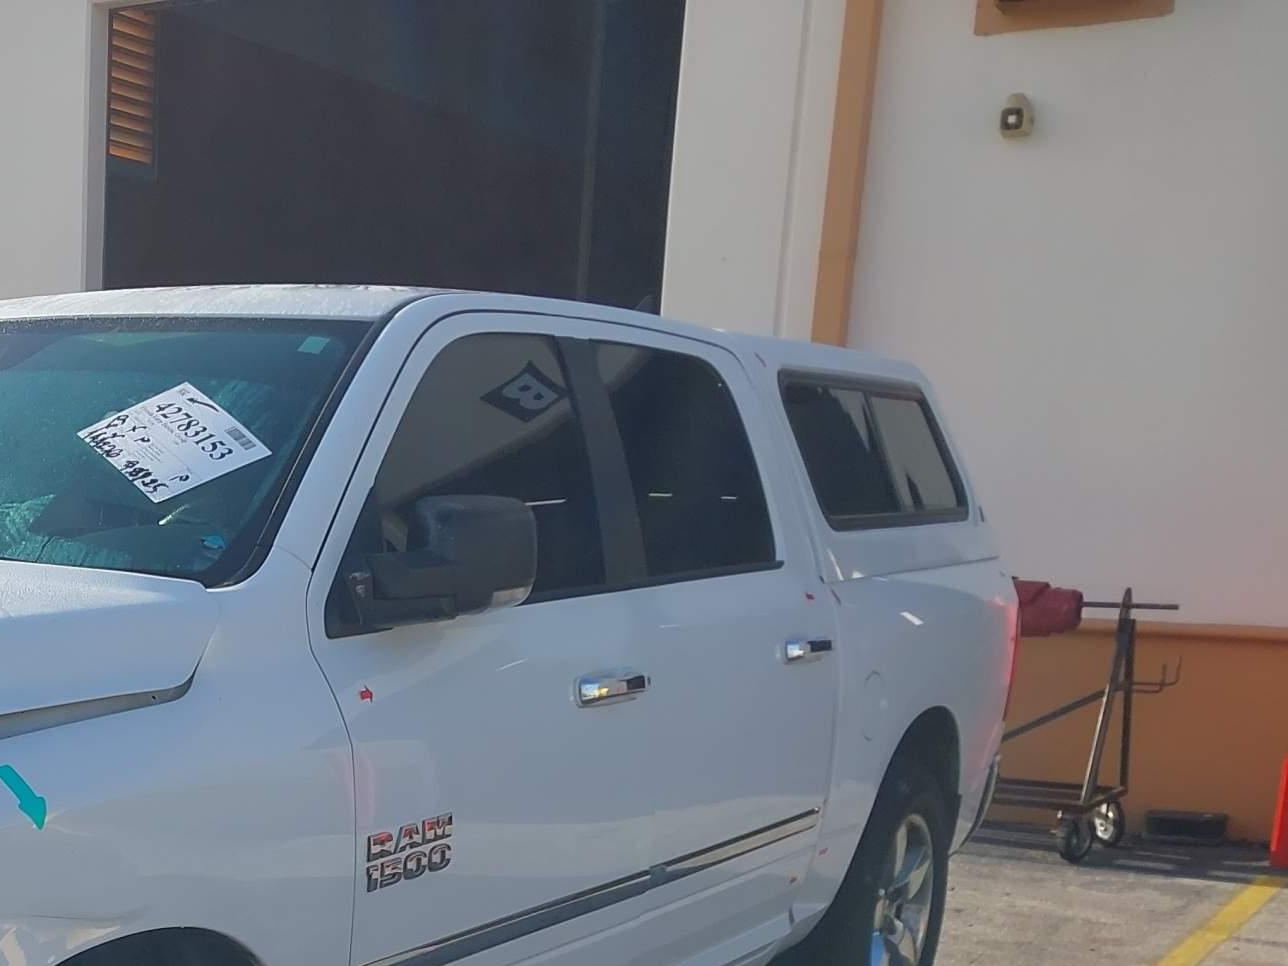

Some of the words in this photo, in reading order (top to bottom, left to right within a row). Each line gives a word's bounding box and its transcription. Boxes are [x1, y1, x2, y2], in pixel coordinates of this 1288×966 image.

[155, 402, 233, 461] 42783153
[366, 811, 453, 863] RAM
[366, 843, 452, 893] 1500
